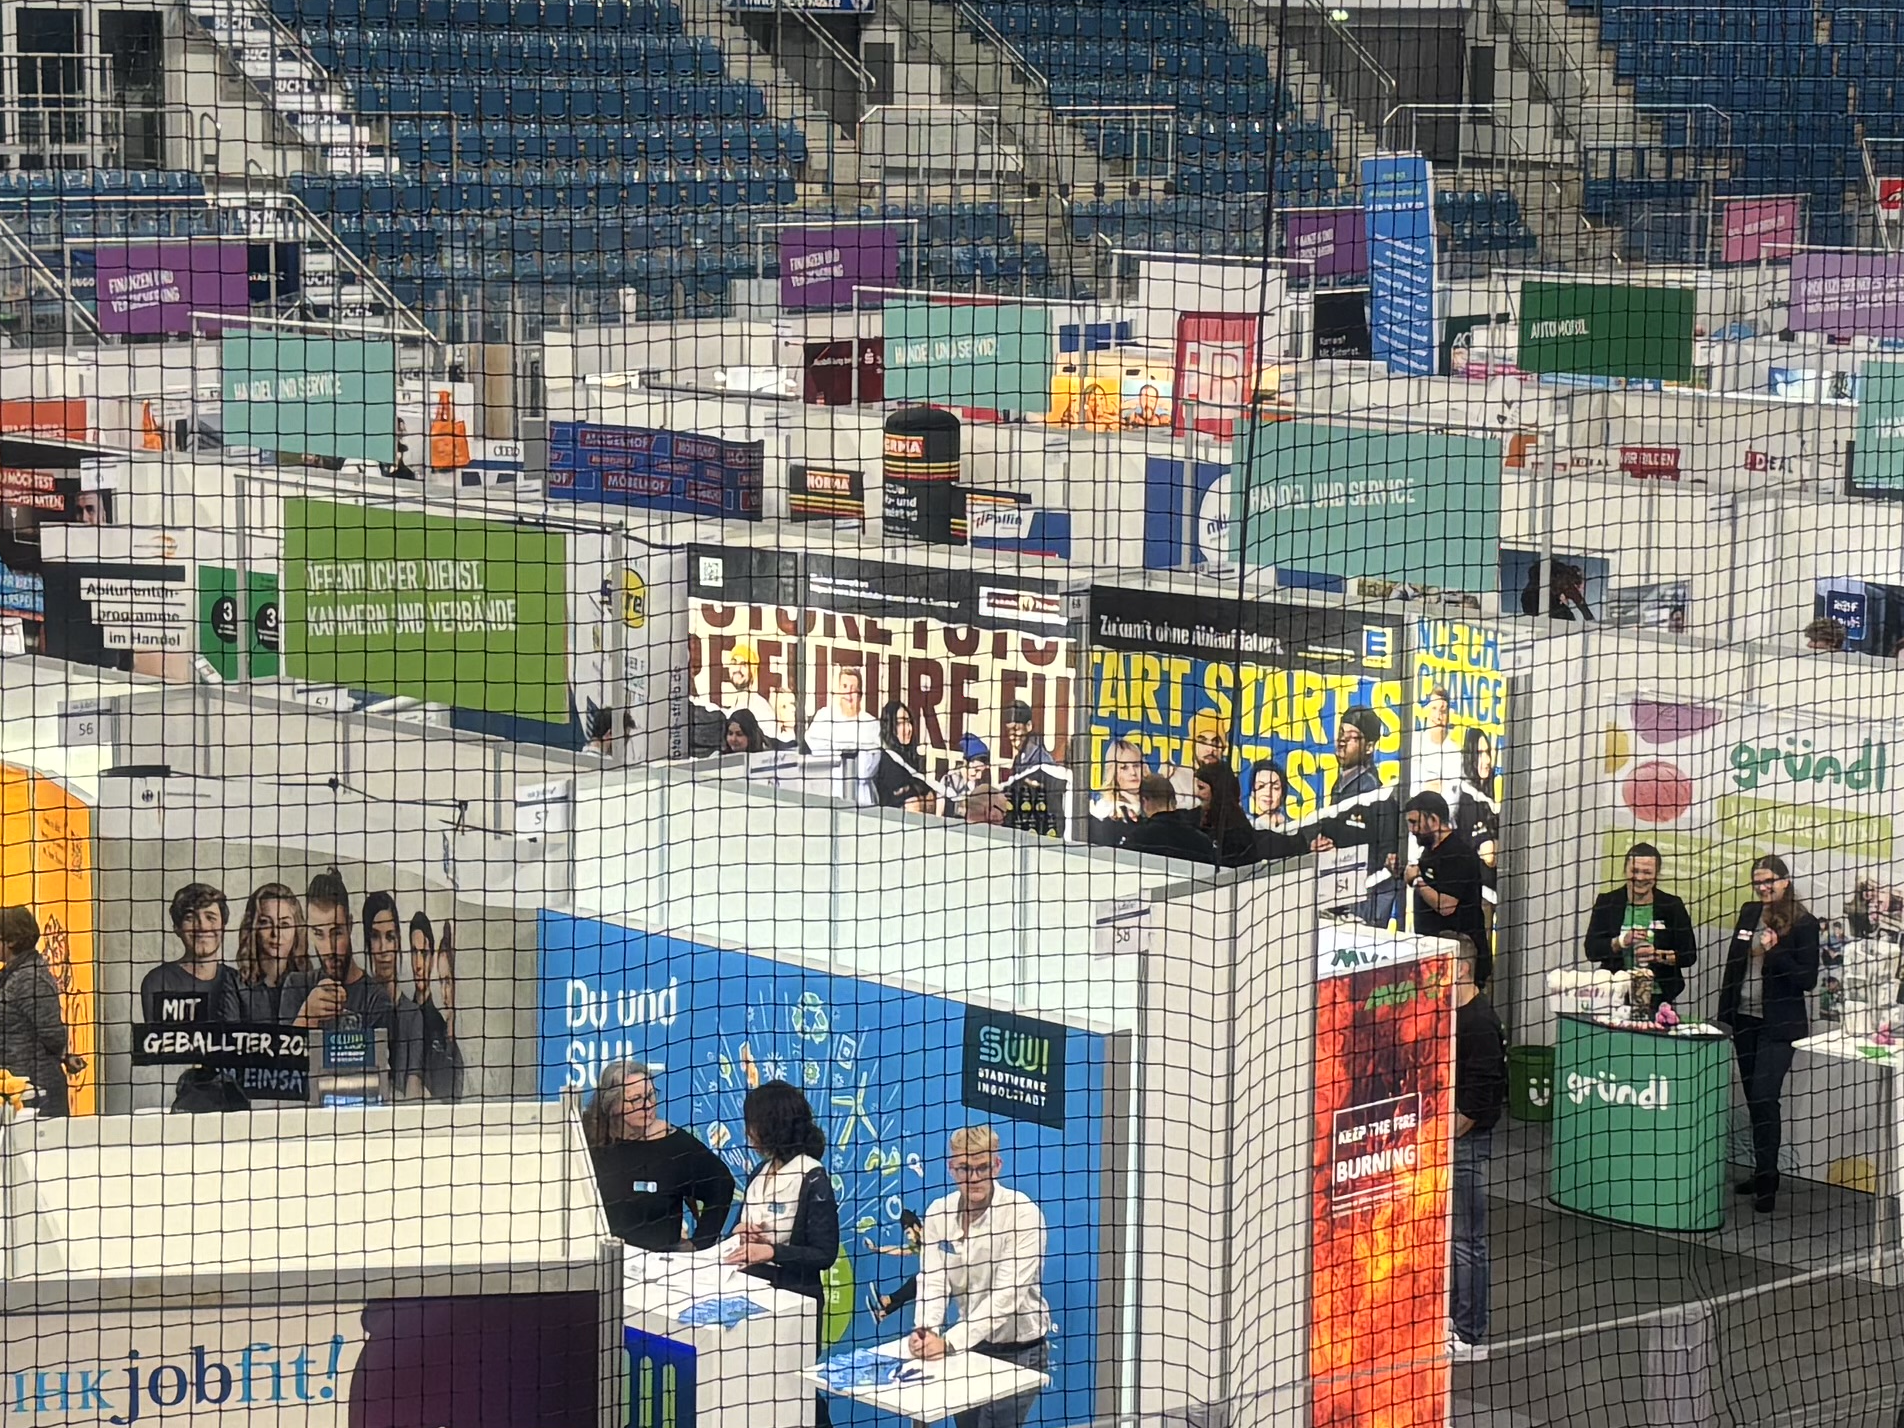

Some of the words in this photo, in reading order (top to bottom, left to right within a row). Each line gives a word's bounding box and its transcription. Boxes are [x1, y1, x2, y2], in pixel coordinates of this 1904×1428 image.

[604, 472, 666, 491] MÖBELHOF
[806, 471, 851, 494] NORMA
[1348, 474, 1417, 506] SERVICE
[307, 602, 390, 636] KAMMERN
[396, 603, 426, 633] UND
[430, 596, 516, 633] VERBÄNDE
[110, 631, 126, 649] im
[129, 629, 182, 650] Handel
[1156, 621, 1190, 647] ohne
[1730, 737, 1886, 792] gründl
[162, 998, 201, 1021] MIT
[564, 978, 610, 1031] Du
[618, 985, 679, 1027] und
[1567, 1069, 1669, 1111] gründl
[1335, 1143, 1418, 1182] BURNING
